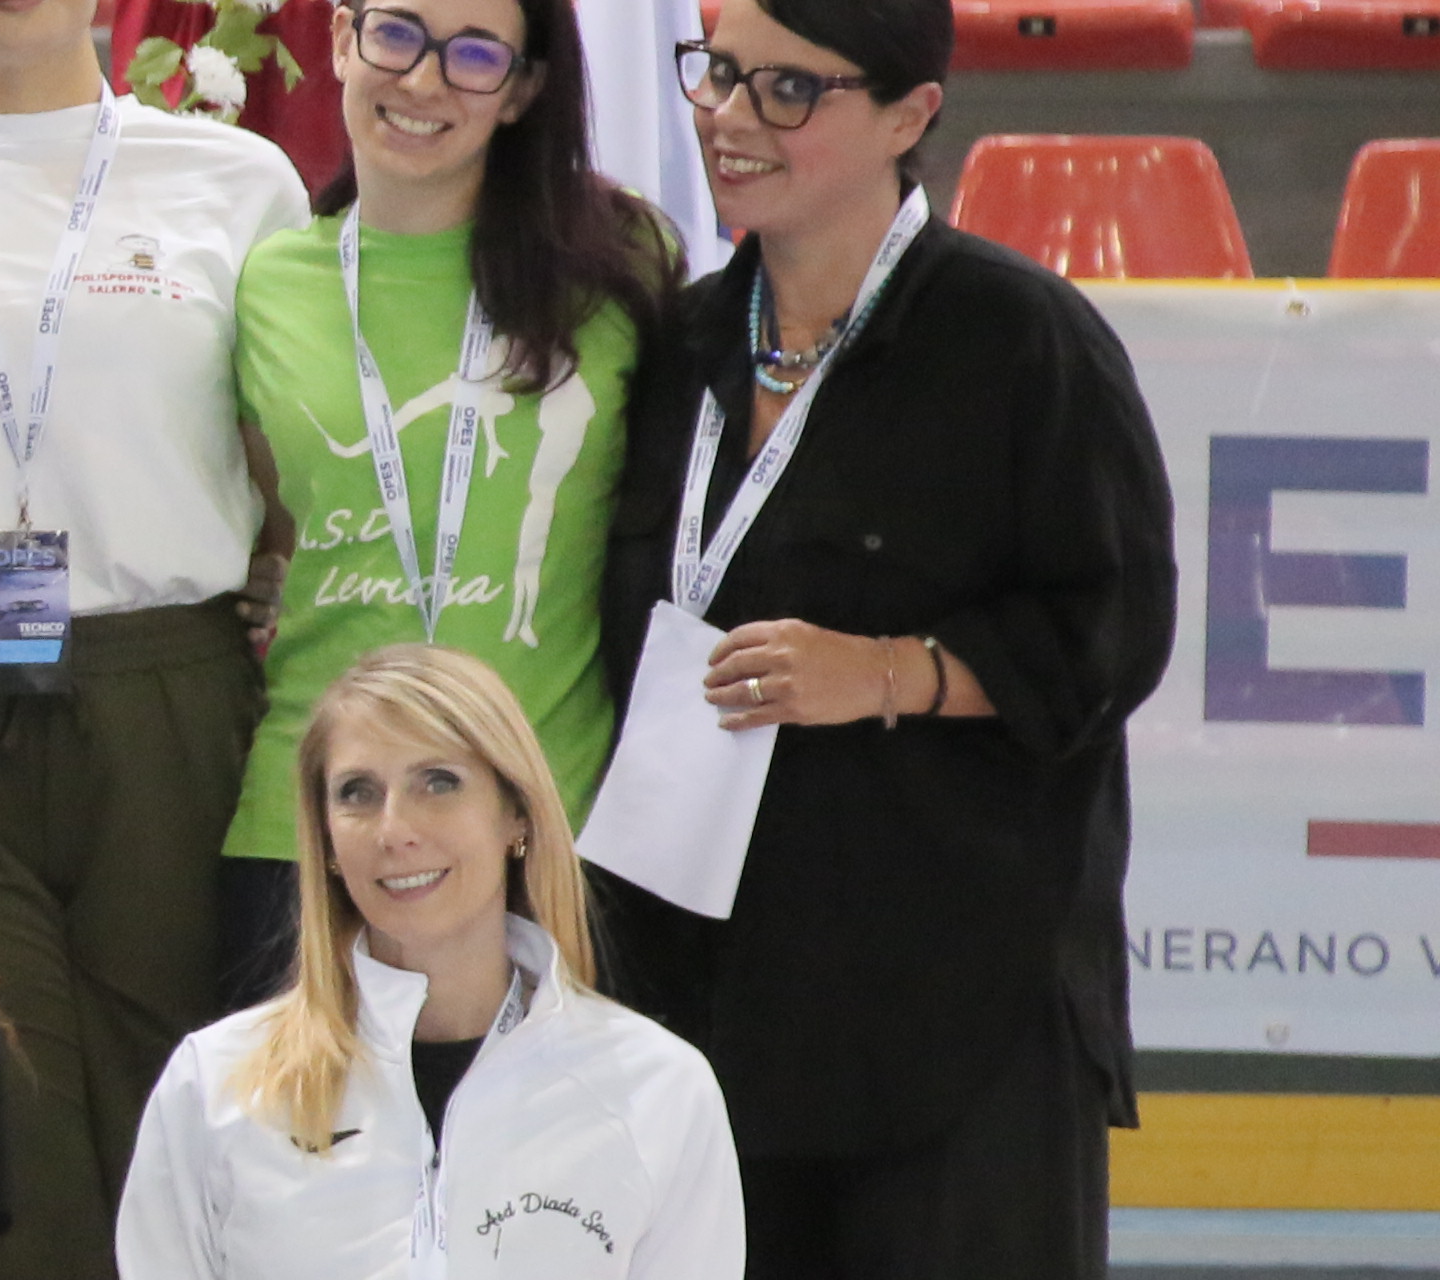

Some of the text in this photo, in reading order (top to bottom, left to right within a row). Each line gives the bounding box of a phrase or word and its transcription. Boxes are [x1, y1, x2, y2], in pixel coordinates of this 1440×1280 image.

[68, 201, 85, 230] OPES
[88, 286, 146, 294] SALERNO
[40, 298, 56, 333] OPES
[461, 407, 476, 446] OPES
[381, 461, 397, 500] OPES
[752, 447, 779, 484] OPES
[686, 516, 699, 554] OPES
[689, 564, 712, 601] OPES
[18, 622, 65, 632] TECNICO
[1128, 928, 1391, 977] NERANO
